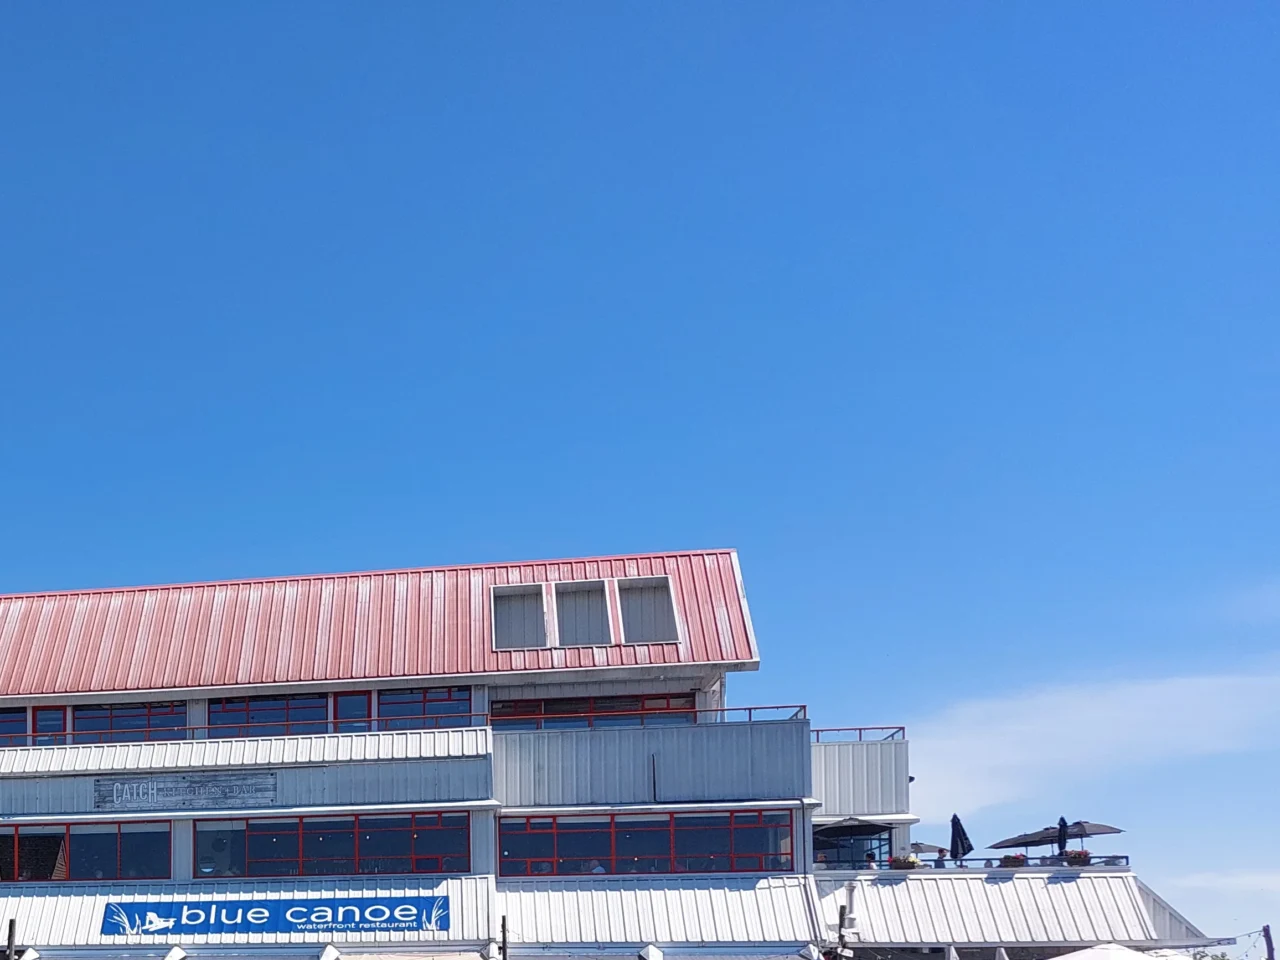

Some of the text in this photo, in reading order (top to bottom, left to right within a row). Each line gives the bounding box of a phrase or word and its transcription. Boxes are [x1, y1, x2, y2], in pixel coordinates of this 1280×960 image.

[113, 781, 157, 804] CATCH
[163, 785, 222, 797] KITCHEN
[233, 785, 257, 794] BAR
[181, 904, 418, 925] blue canoe
[297, 921, 418, 930] waterfront restaurant
